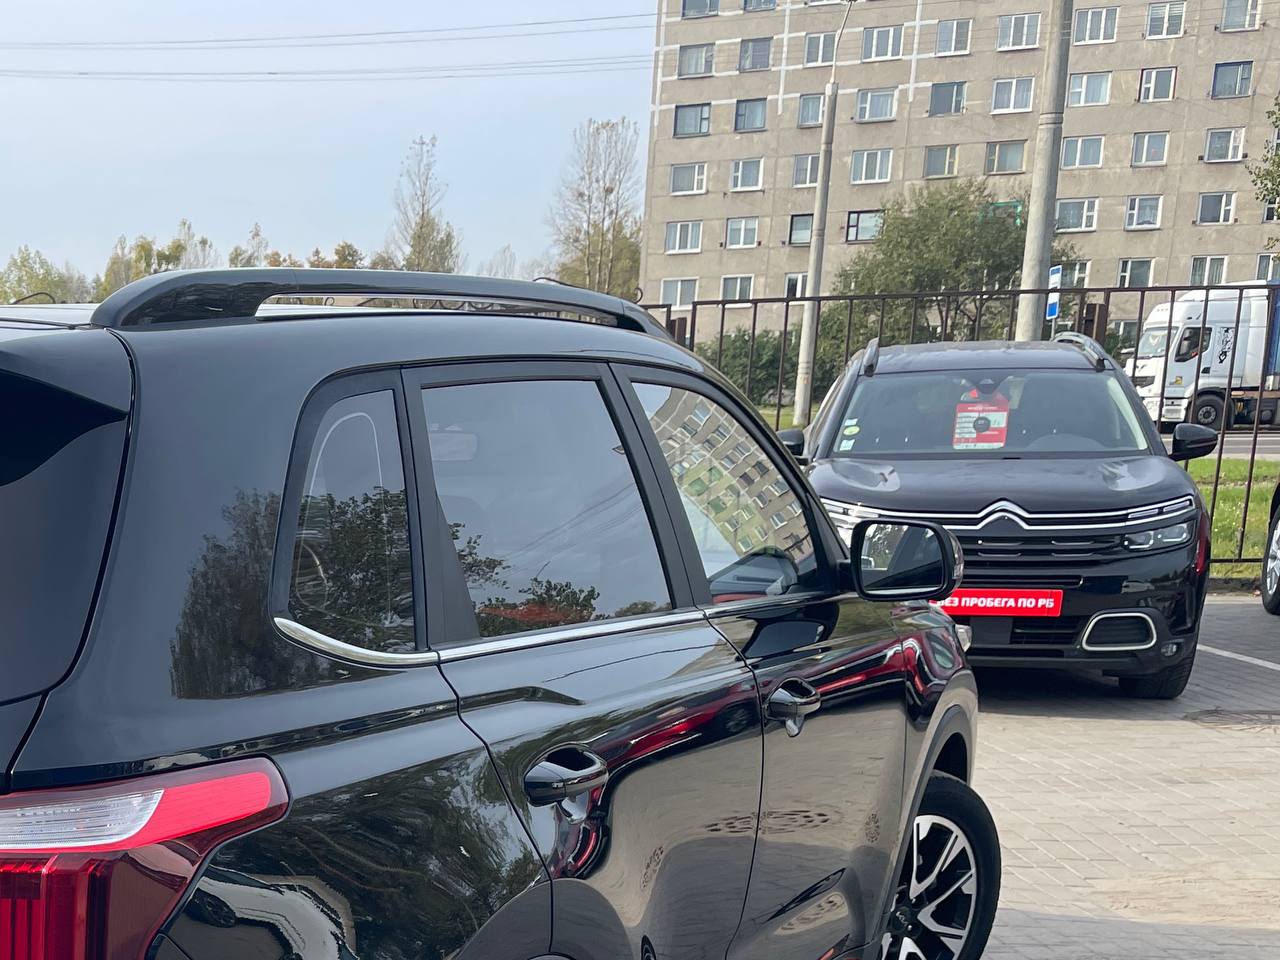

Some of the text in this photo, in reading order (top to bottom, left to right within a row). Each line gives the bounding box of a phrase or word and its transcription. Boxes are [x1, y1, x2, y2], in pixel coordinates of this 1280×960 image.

[961, 597, 1015, 608] ПРОБЕГА
[1017, 598, 1036, 608] ПО
[1037, 598, 1055, 608] РБ
